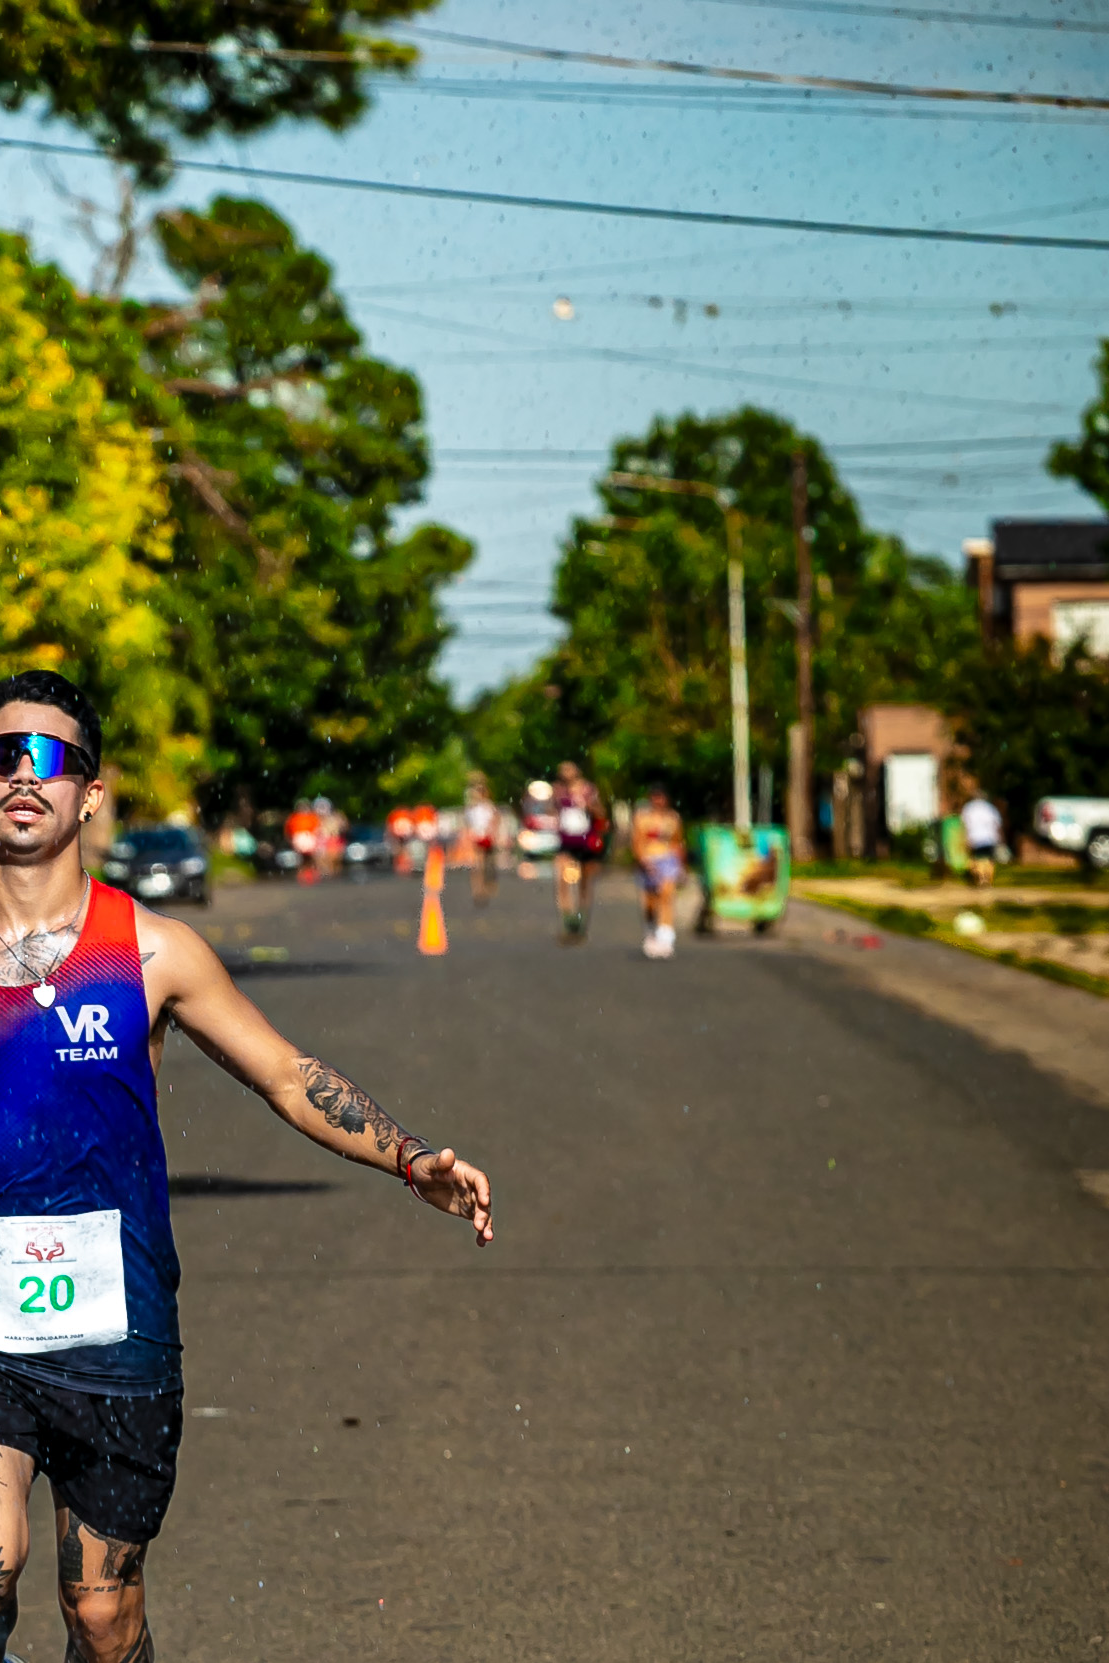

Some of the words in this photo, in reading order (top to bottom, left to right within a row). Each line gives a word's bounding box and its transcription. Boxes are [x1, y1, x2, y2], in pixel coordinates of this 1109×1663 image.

[55, 1004, 114, 1043] VR
[55, 1047, 118, 1062] TEAM
[19, 1274, 75, 1313] 20
